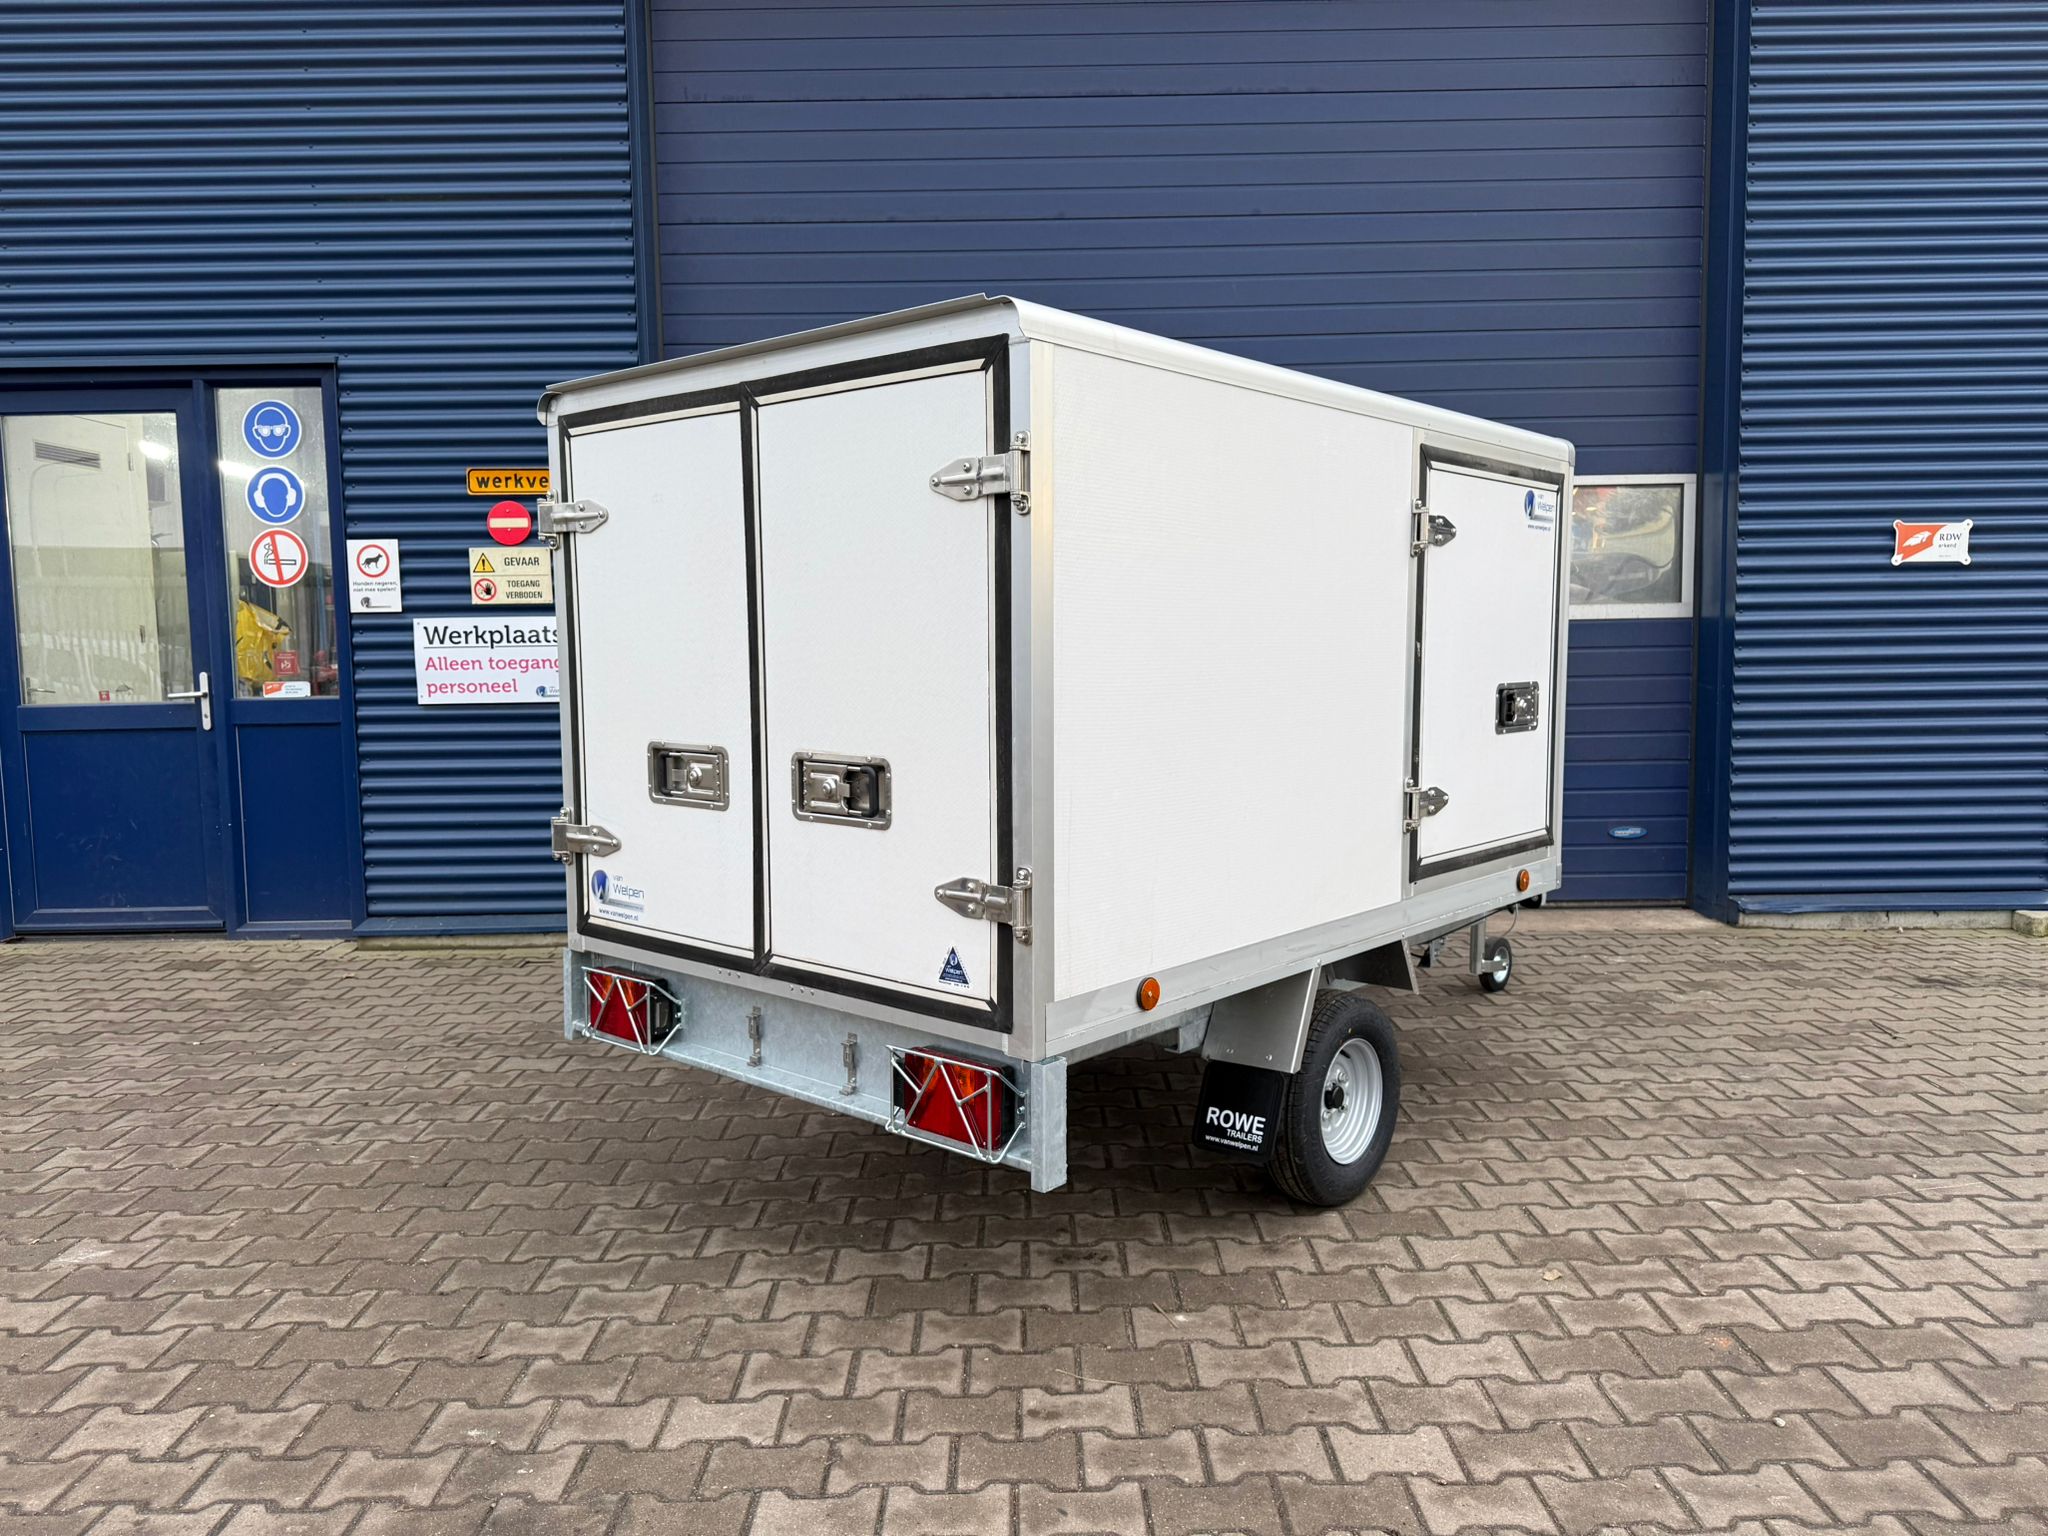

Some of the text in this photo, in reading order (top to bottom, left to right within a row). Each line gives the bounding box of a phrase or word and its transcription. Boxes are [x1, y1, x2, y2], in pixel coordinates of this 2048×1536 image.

[476, 473, 549, 488] werkve
[1939, 533, 1962, 541] RDW
[504, 557, 540, 567] GEVAAR
[507, 579, 541, 588] TOEGANG
[505, 590, 543, 599] VERBODEN
[425, 656, 482, 671] Alleen
[426, 678, 518, 697] personeel
[613, 883, 645, 900] Welpen
[1206, 1106, 1266, 1136] ROWE
[1205, 1134, 1259, 1151] www.vanwelpen.nl
[1226, 1129, 1263, 1144] TRAILERS
